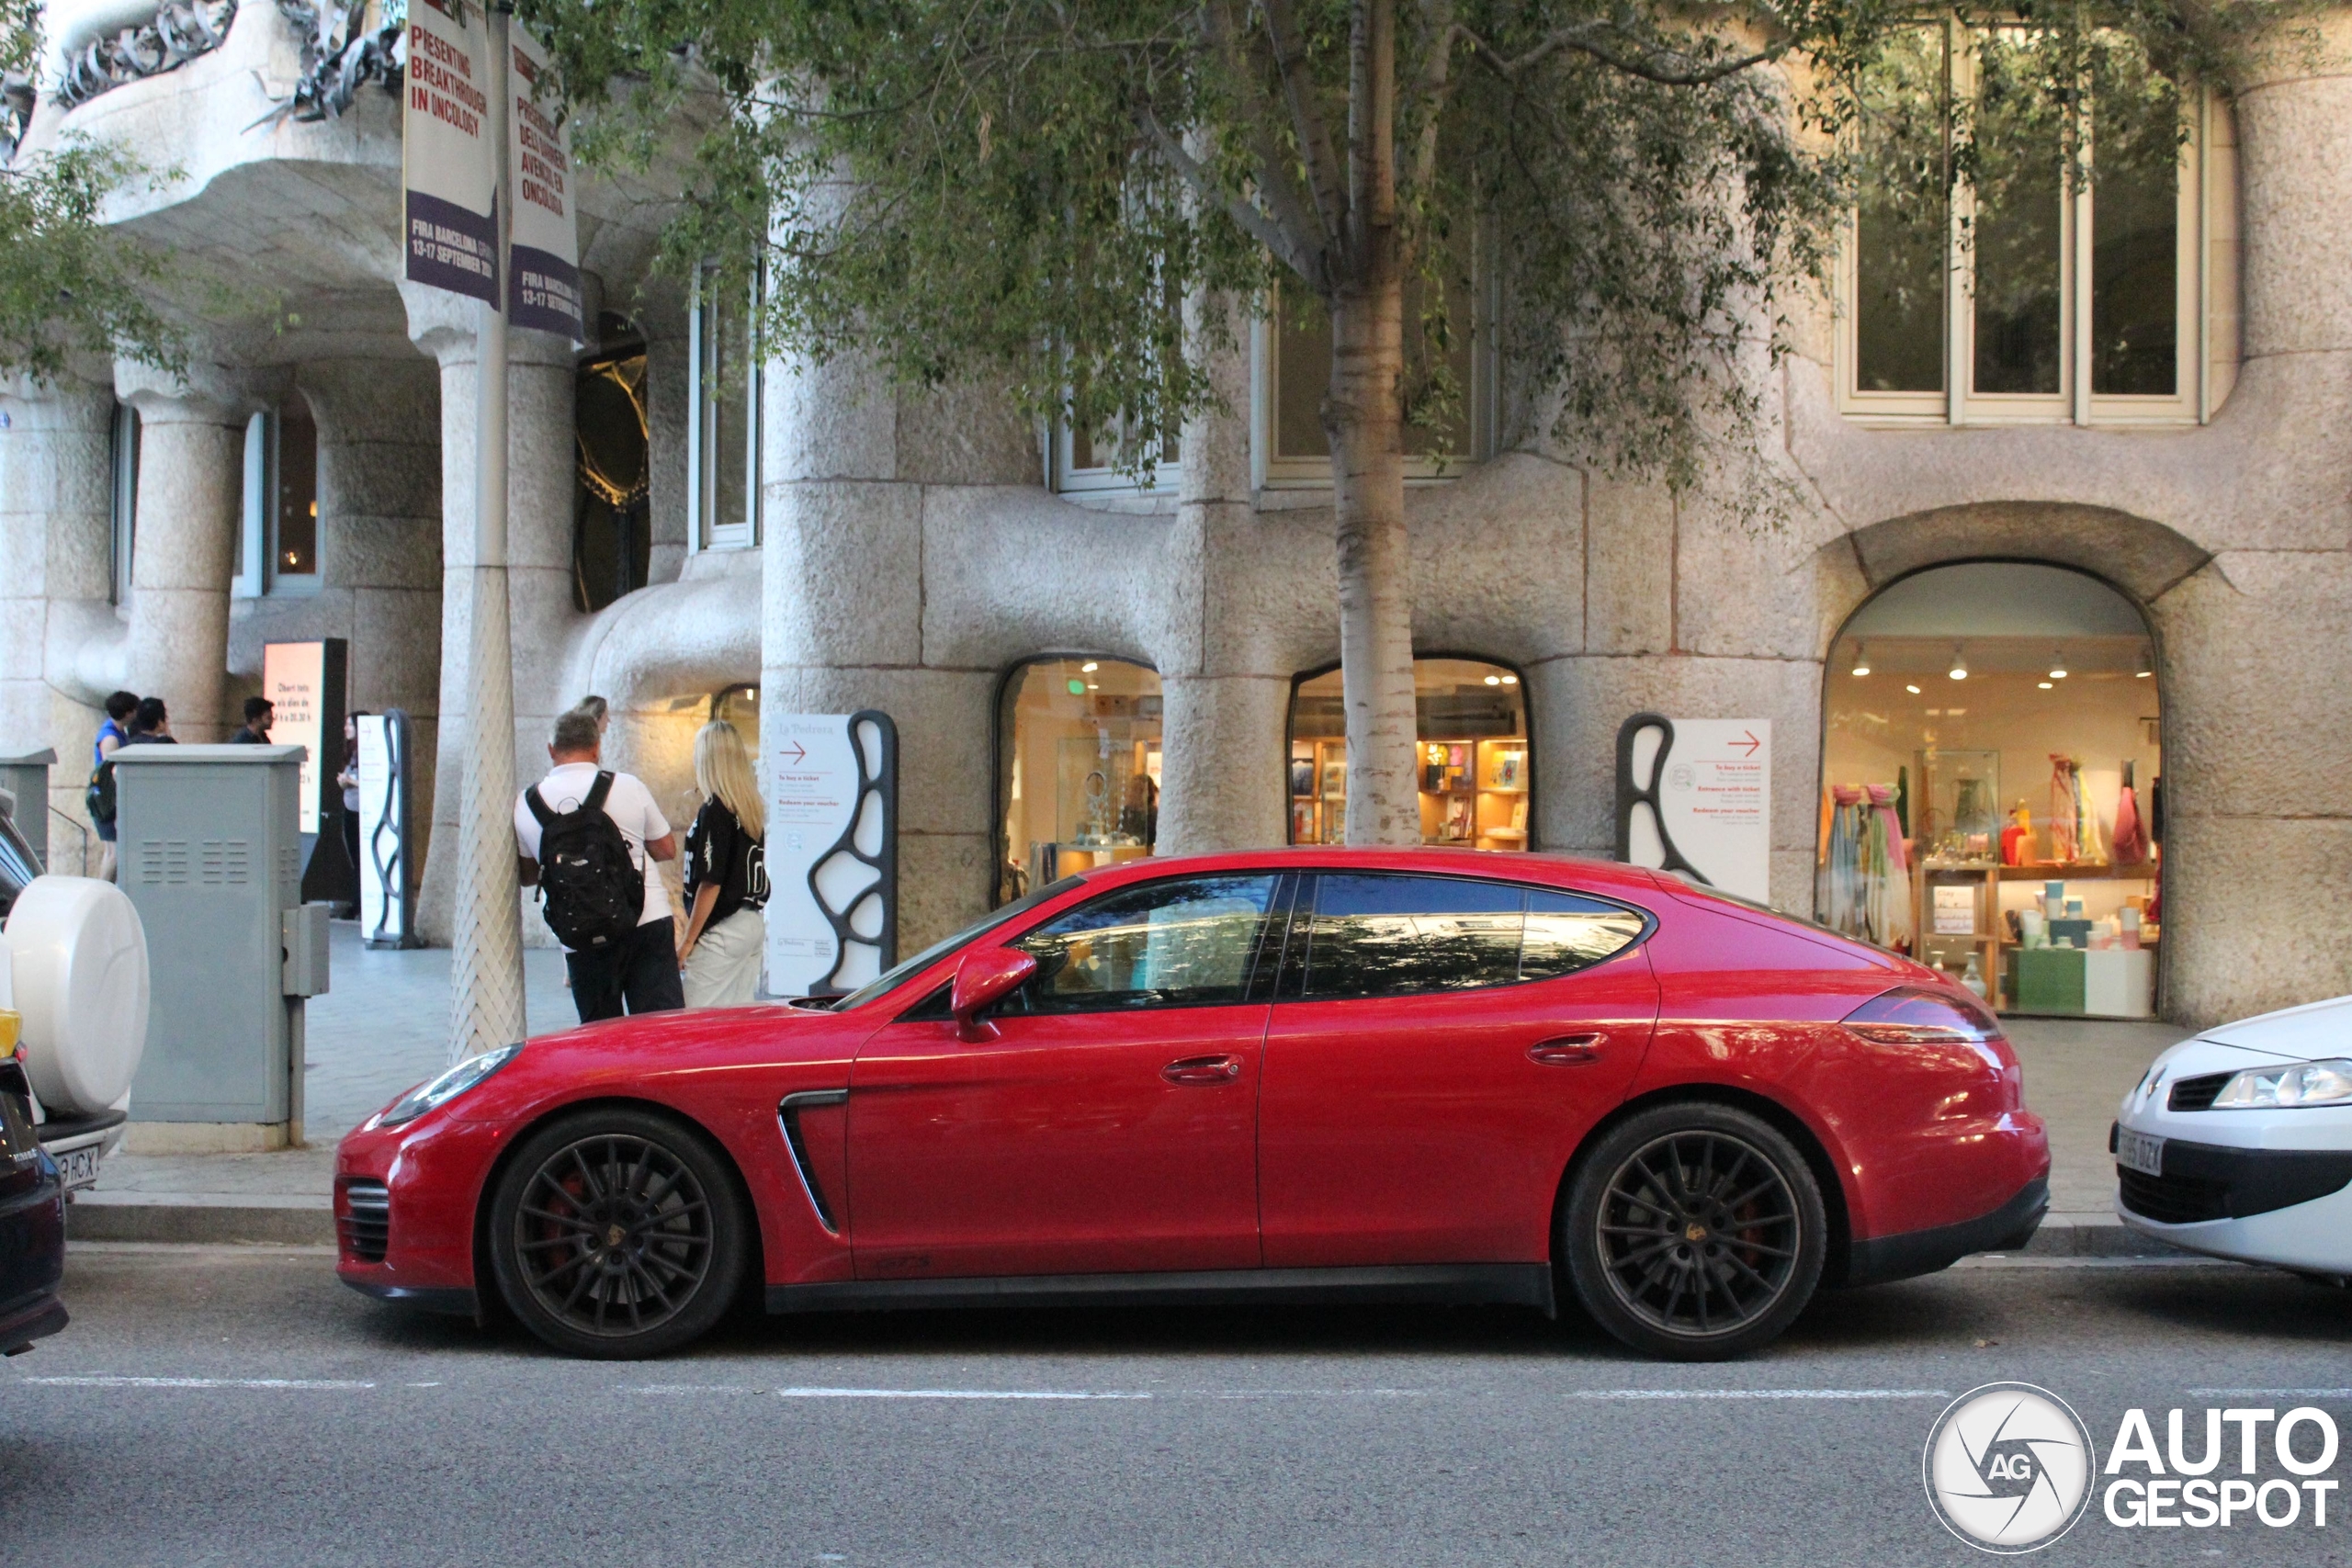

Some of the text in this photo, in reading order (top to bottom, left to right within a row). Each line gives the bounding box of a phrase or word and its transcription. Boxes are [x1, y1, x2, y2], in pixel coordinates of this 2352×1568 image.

[411, 25, 470, 79] PRESENTING
[411, 85, 478, 139] IN ONCOLOGY
[412, 218, 434, 240] FIRA
[435, 224, 478, 254] BARCELONA
[412, 239, 435, 260] 13-17
[436, 245, 481, 274] SEPTEMBER
[522, 270, 544, 289] FIRA
[522, 288, 546, 308] 13-17
[791, 723, 833, 735] Pedrera
